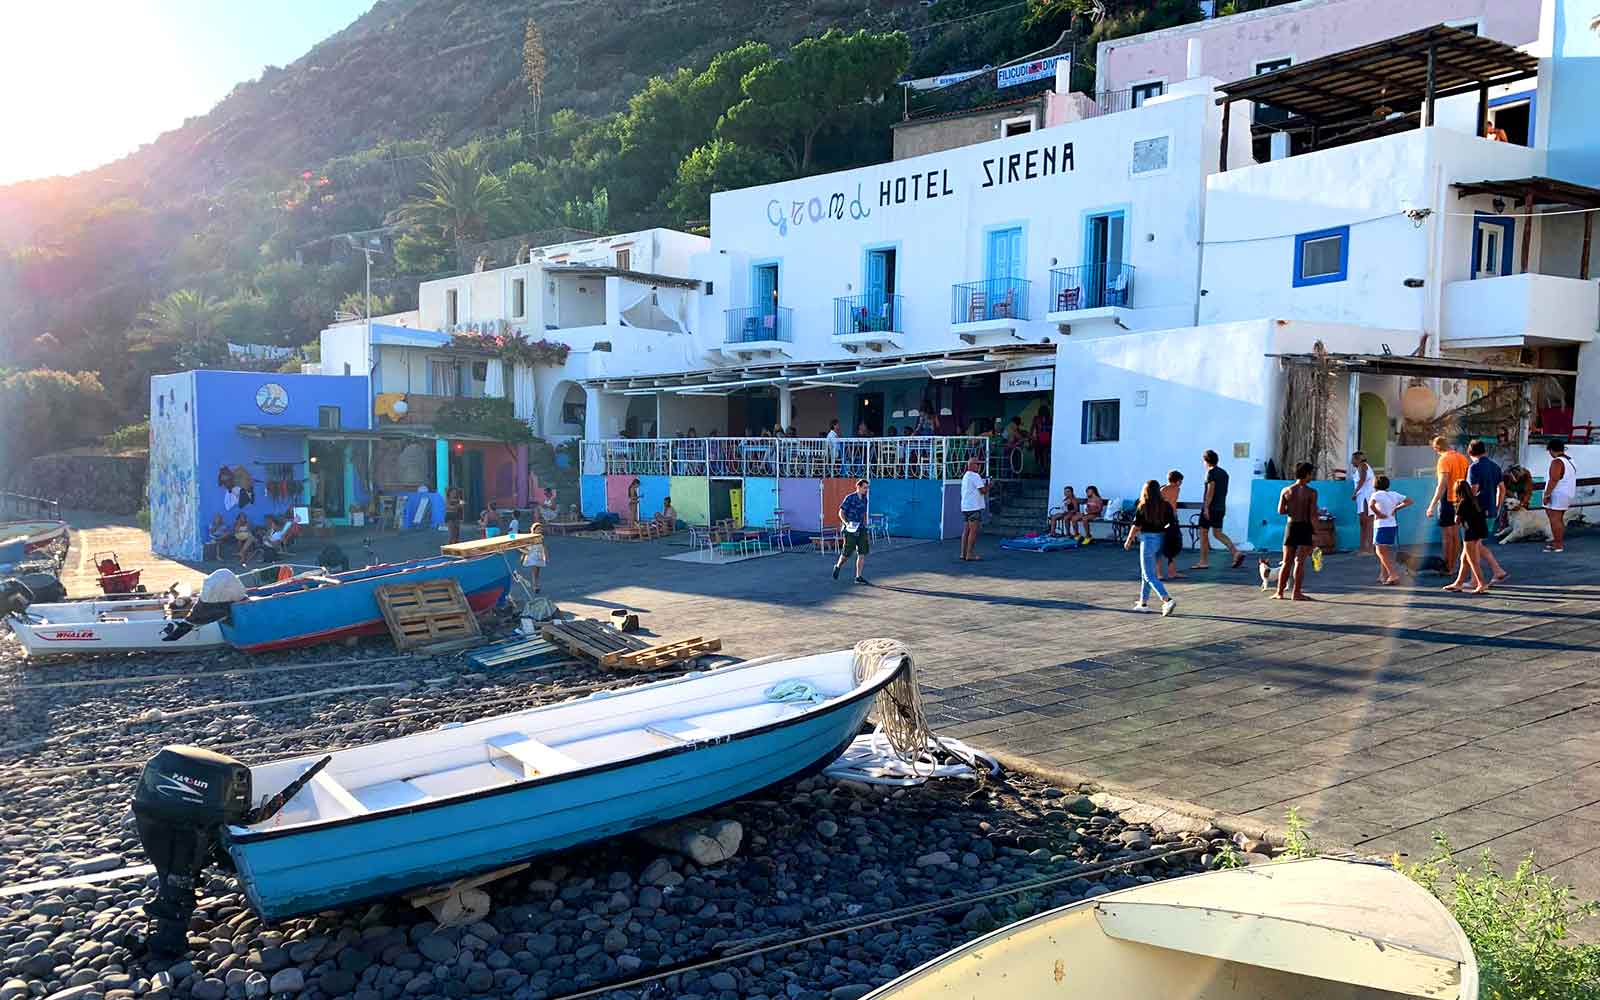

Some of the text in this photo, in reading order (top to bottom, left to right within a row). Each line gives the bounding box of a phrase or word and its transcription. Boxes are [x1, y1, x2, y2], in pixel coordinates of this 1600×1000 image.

[998, 65, 1028, 81] FILICUDI
[880, 169, 953, 207] HOTEL
[982, 142, 1075, 188] SIRENA
[56, 631, 94, 639] WHALER
